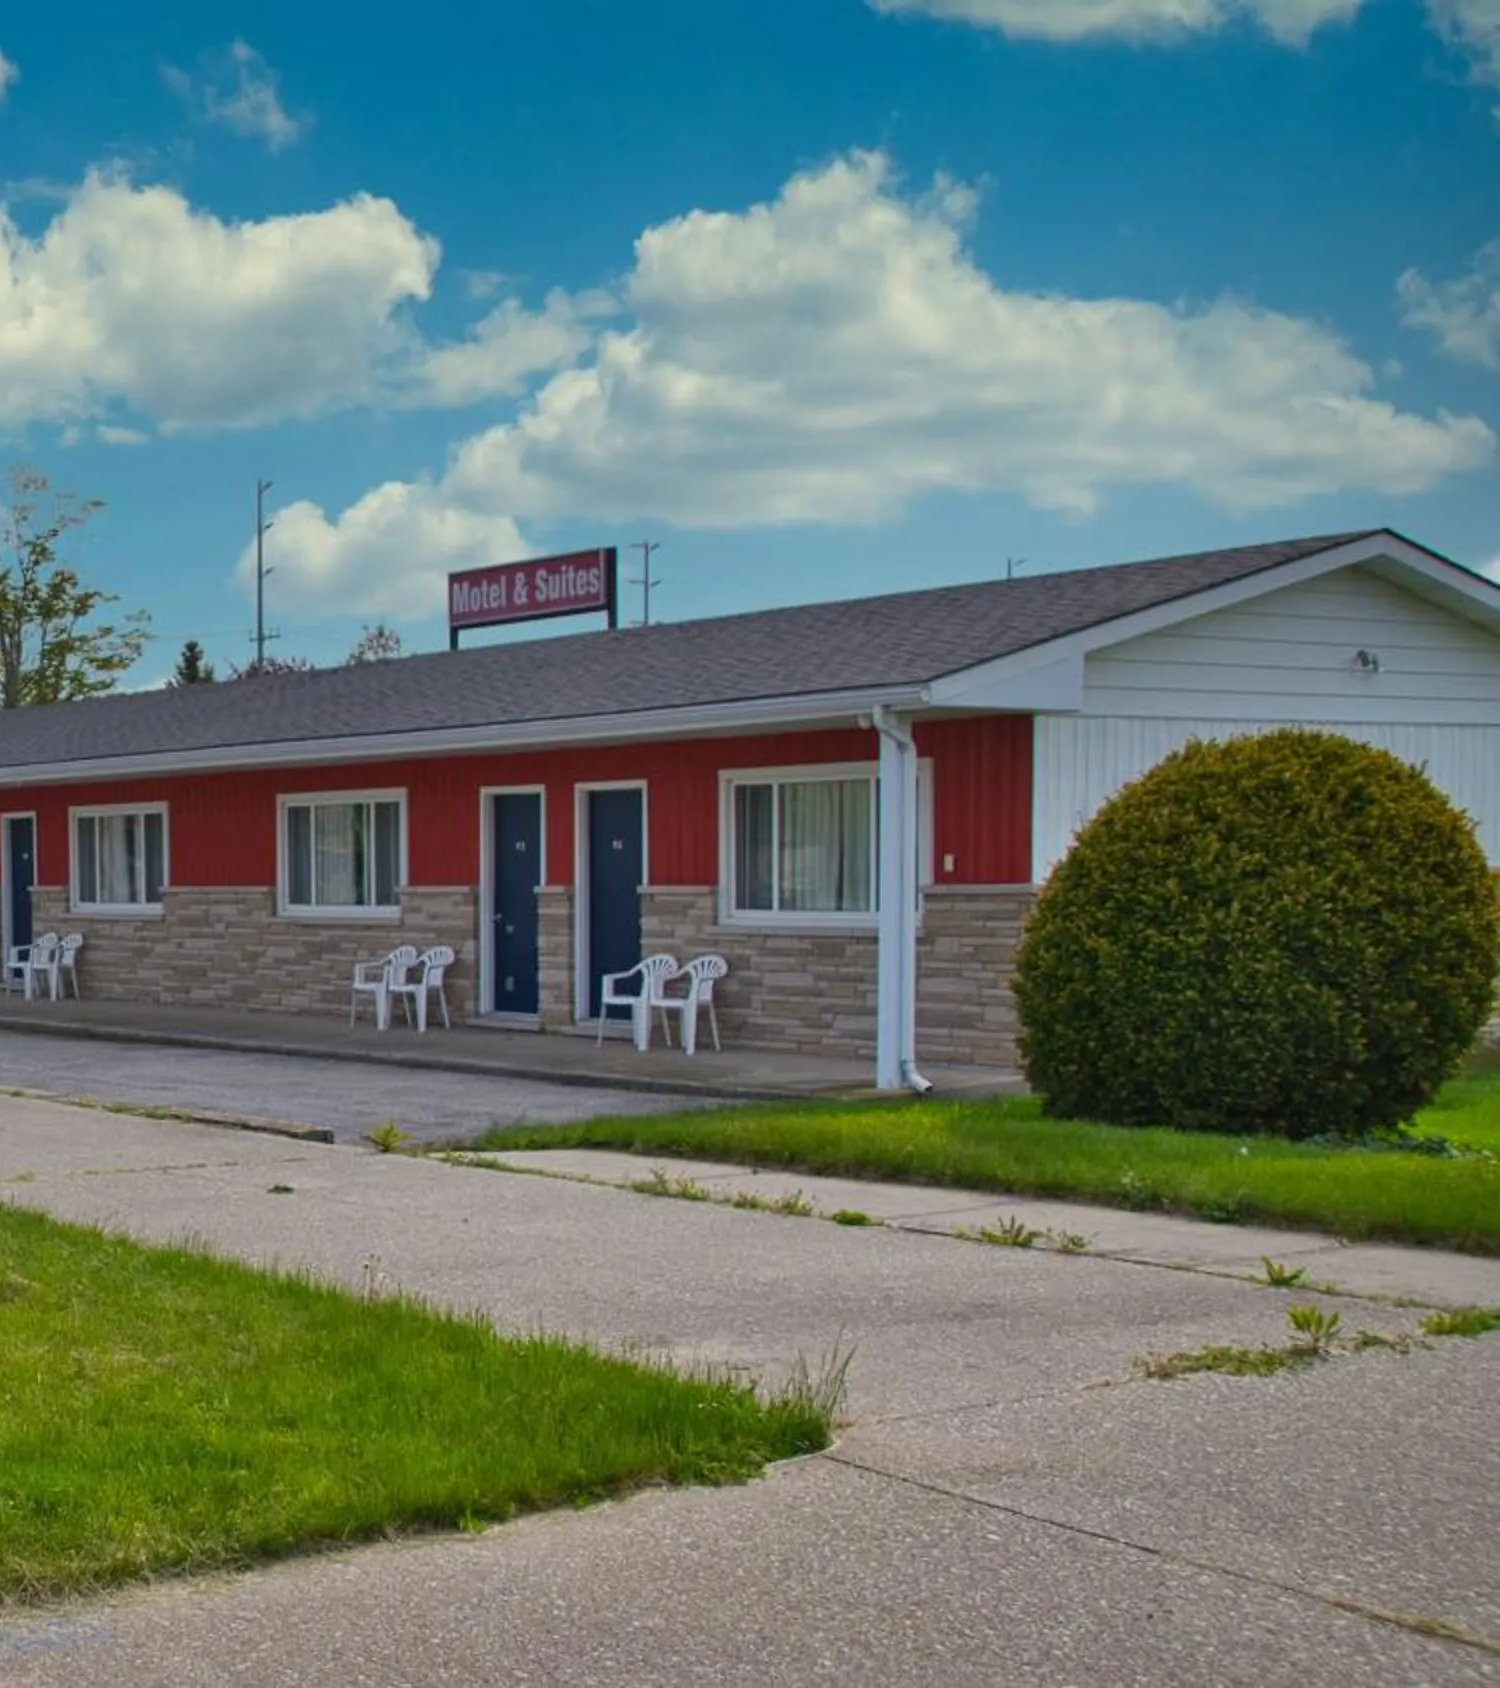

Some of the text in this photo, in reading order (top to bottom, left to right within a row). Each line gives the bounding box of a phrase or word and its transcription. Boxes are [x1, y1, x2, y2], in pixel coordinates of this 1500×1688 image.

[452, 564, 599, 613] Motel & Suites
